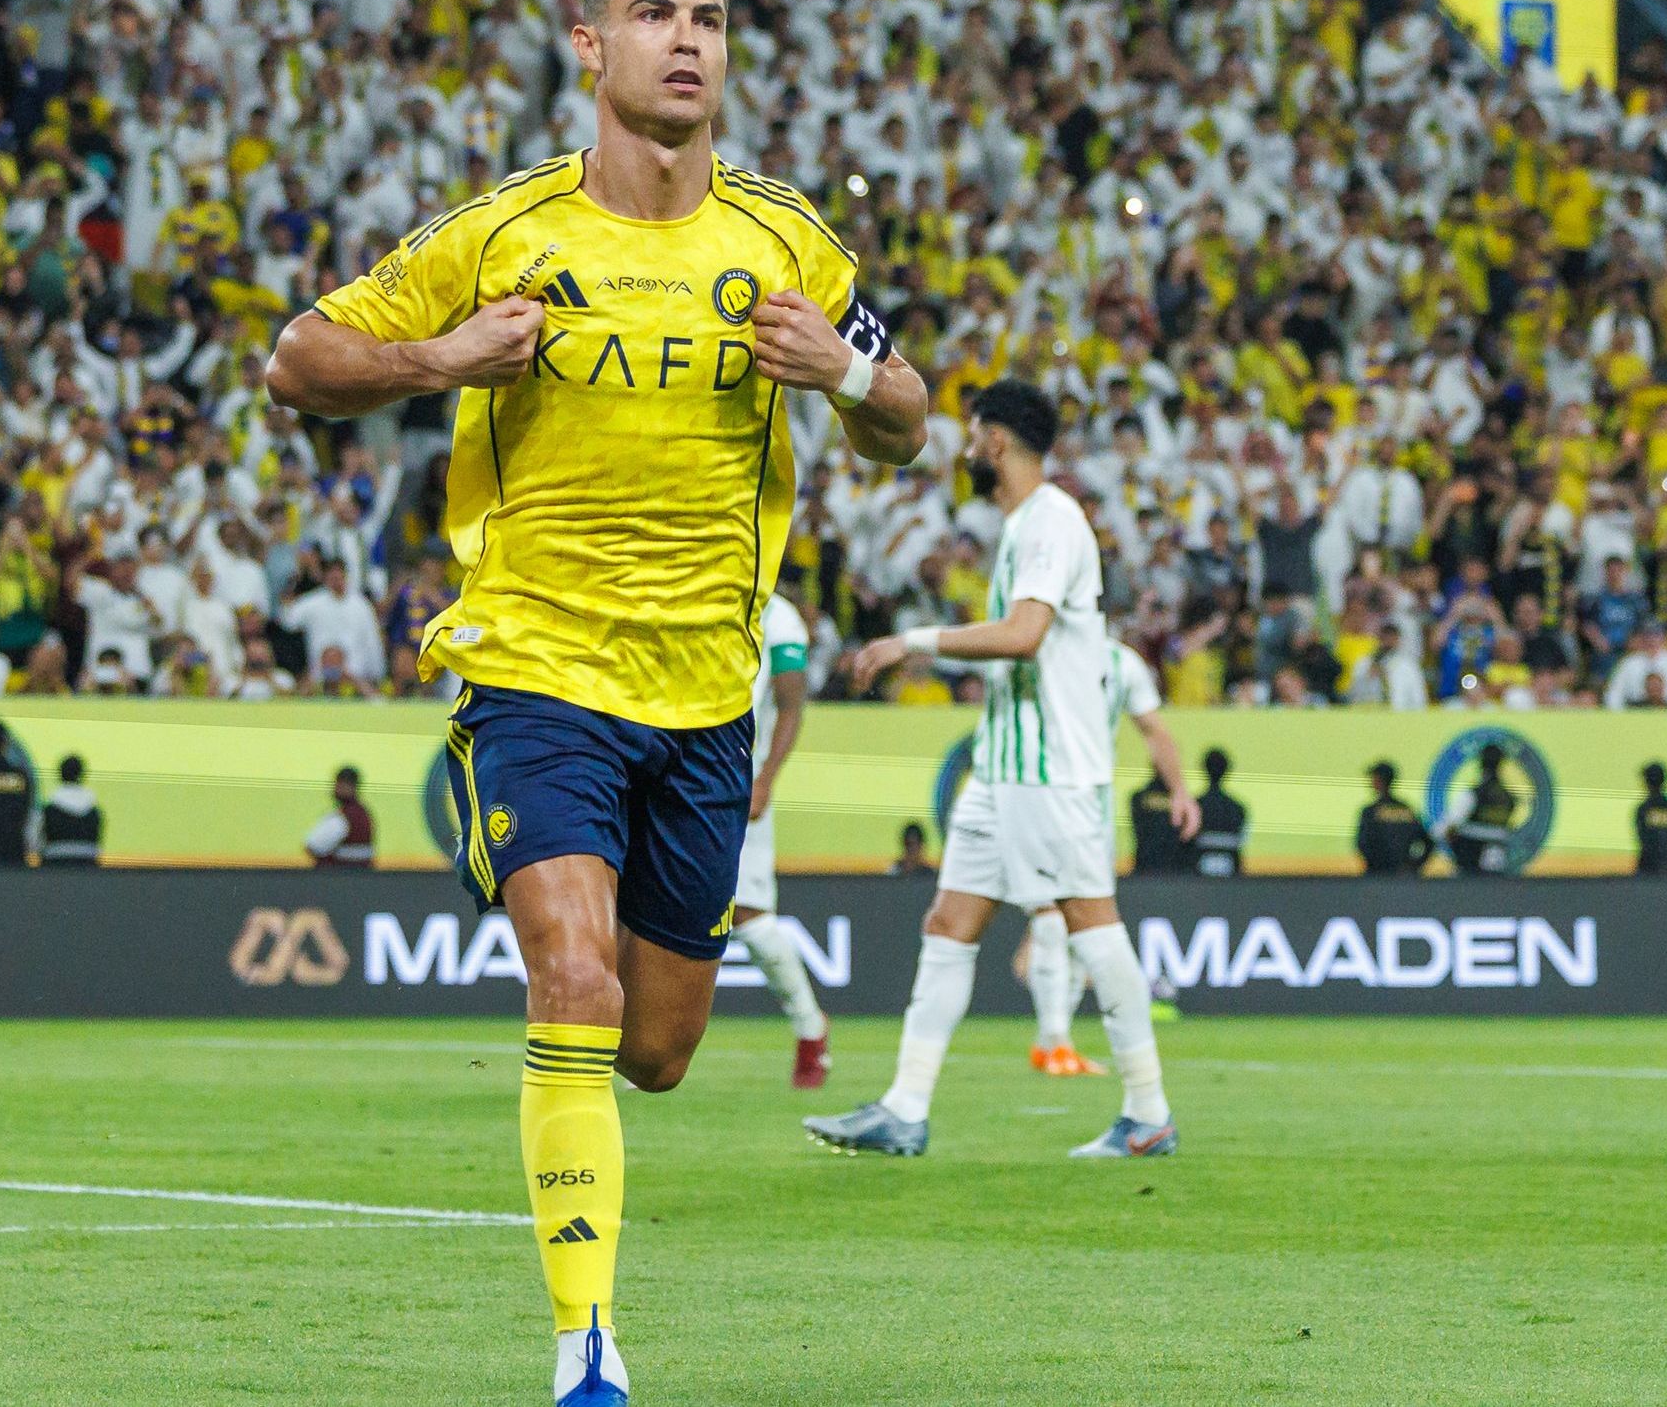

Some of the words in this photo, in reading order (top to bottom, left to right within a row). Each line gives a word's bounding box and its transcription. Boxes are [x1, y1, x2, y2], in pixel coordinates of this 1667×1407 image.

[533, 330, 755, 392] KAFD
[1139, 916, 1598, 987] MAADEN
[536, 1169, 595, 1190] 1955
